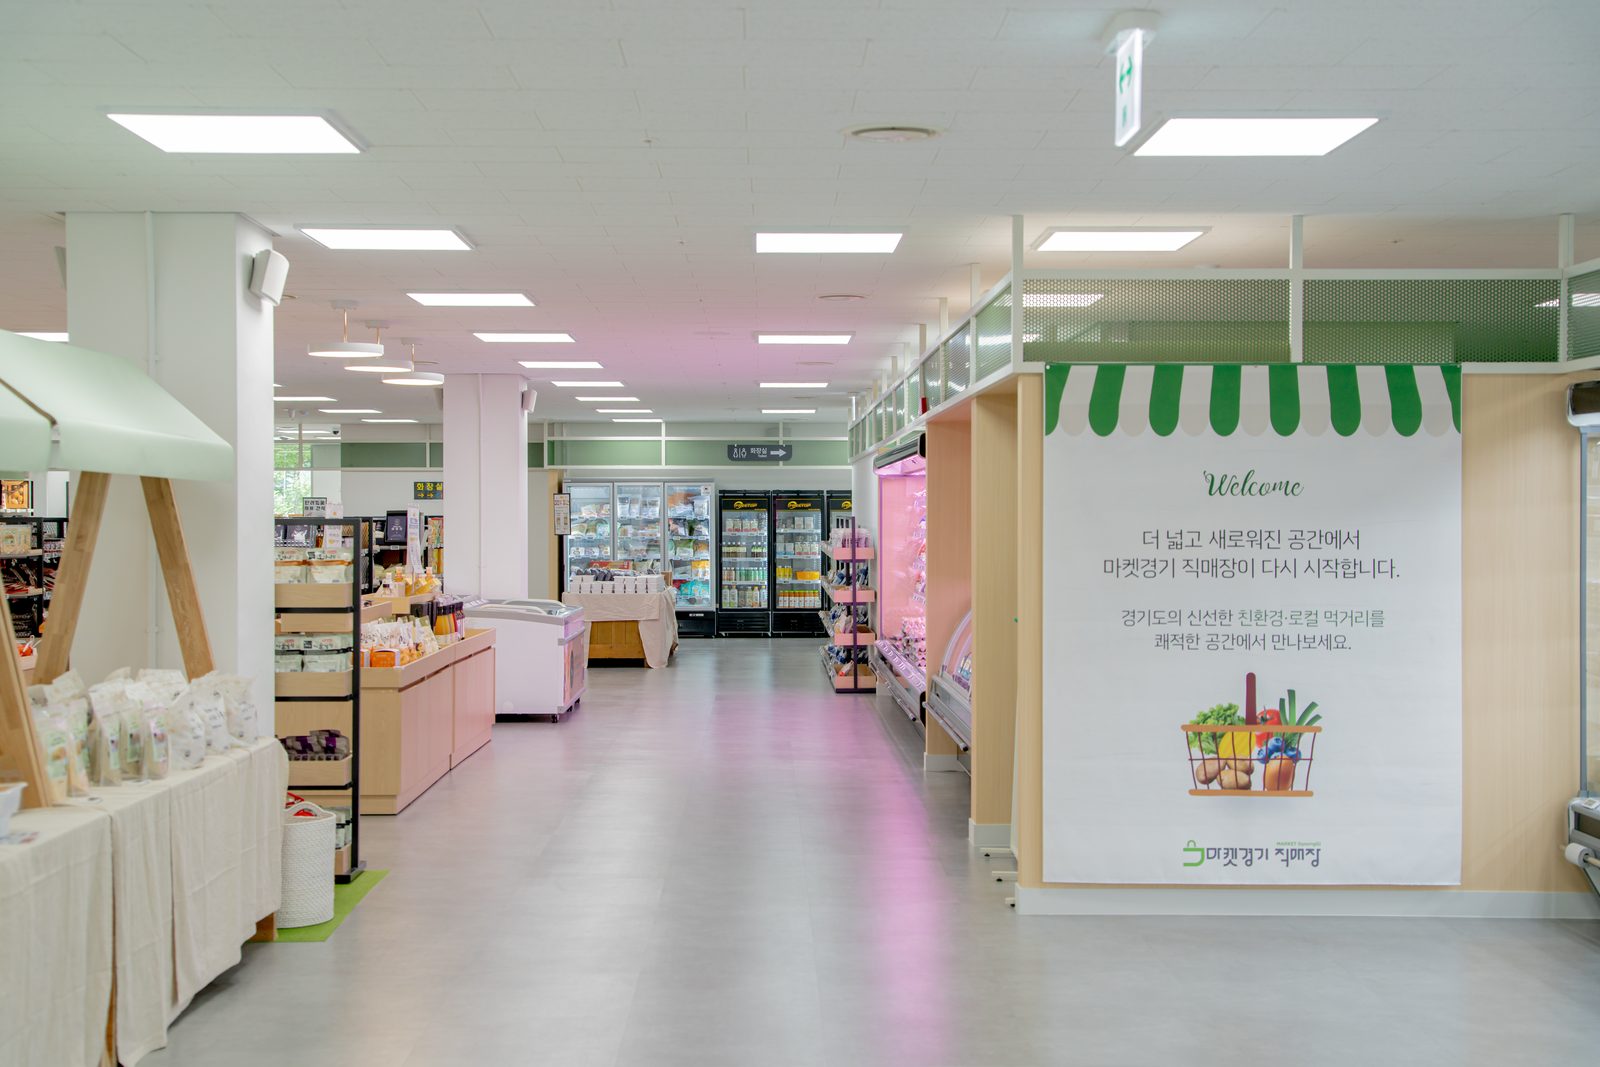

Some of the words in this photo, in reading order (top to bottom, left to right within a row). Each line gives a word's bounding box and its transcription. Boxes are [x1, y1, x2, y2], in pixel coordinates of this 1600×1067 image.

[750, 447, 767, 455] 화장실
[416, 482, 443, 491] 화장실
[1203, 469, 1304, 497] Welcome
[1143, 529, 1160, 550] 더
[1167, 529, 1203, 551] 넓고
[1209, 529, 1281, 550] 새로워진
[1288, 529, 1360, 550] 공간에서
[1104, 558, 1175, 579] 마켓경기
[1182, 558, 1255, 579] 직매장이
[1262, 558, 1297, 579] 다시
[1304, 558, 1400, 580] 시작합니다.
[1122, 609, 1182, 627] 경기도의
[1187, 609, 1234, 627] 신선한
[1239, 609, 1319, 627] 친환경·로컬
[1324, 609, 1385, 627] 먹거리를
[1155, 633, 1201, 651] 쾌적한
[1206, 633, 1266, 651] 공간에서
[1271, 633, 1352, 651] 만나보세요.
[1206, 847, 1269, 868] 마켓경기
[1274, 847, 1322, 868] 직매장
